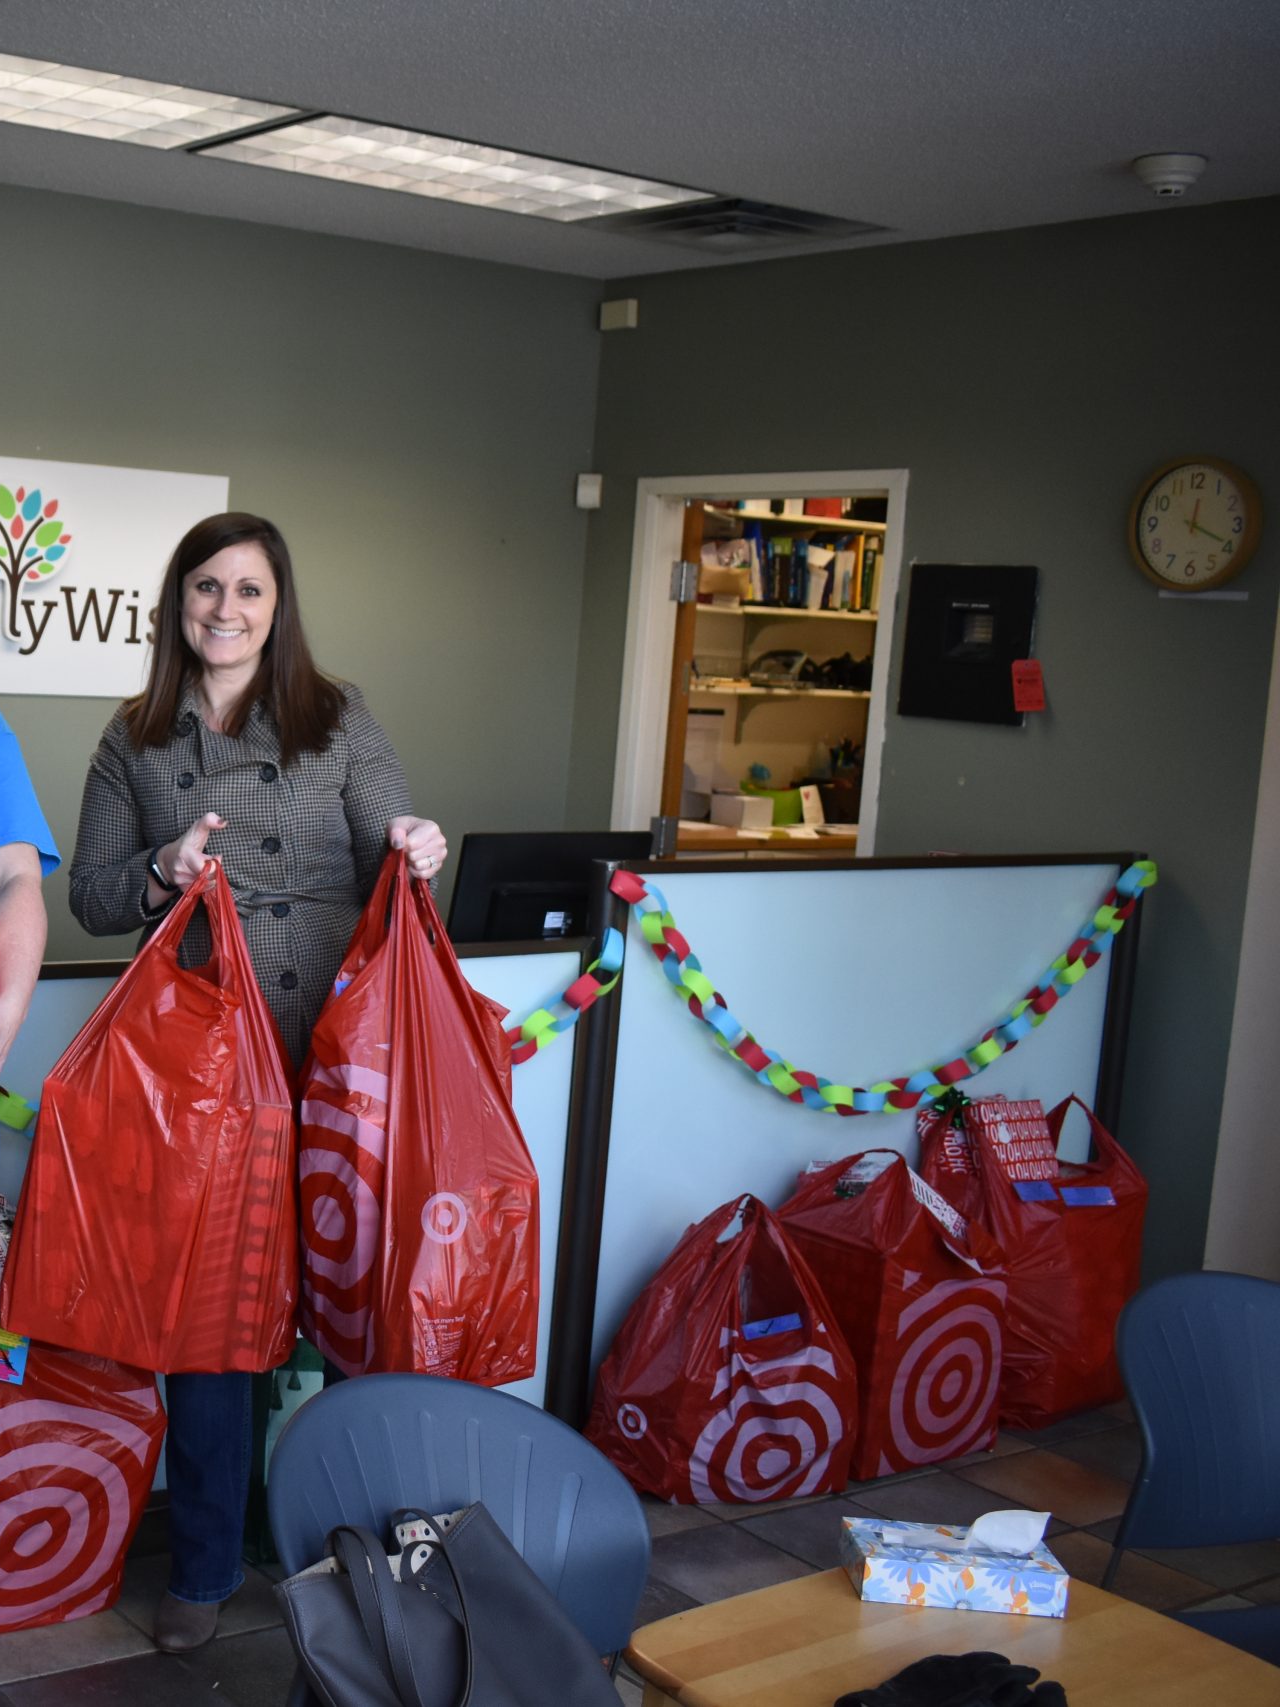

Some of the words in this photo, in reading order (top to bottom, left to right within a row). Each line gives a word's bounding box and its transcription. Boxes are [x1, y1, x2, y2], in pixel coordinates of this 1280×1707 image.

[1172, 479, 1184, 496] 11
[1190, 472, 1206, 490] 12
[1155, 495, 1170, 512] 10
[1227, 495, 1239, 511] 2
[1147, 516, 1159, 533] 9
[1231, 516, 1243, 534] 3
[1151, 538, 1162, 555] 8
[1222, 539, 1234, 554] 4
[1166, 554, 1177, 569] 7
[1184, 560, 1196, 577] 6
[1206, 554, 1217, 571] 5
